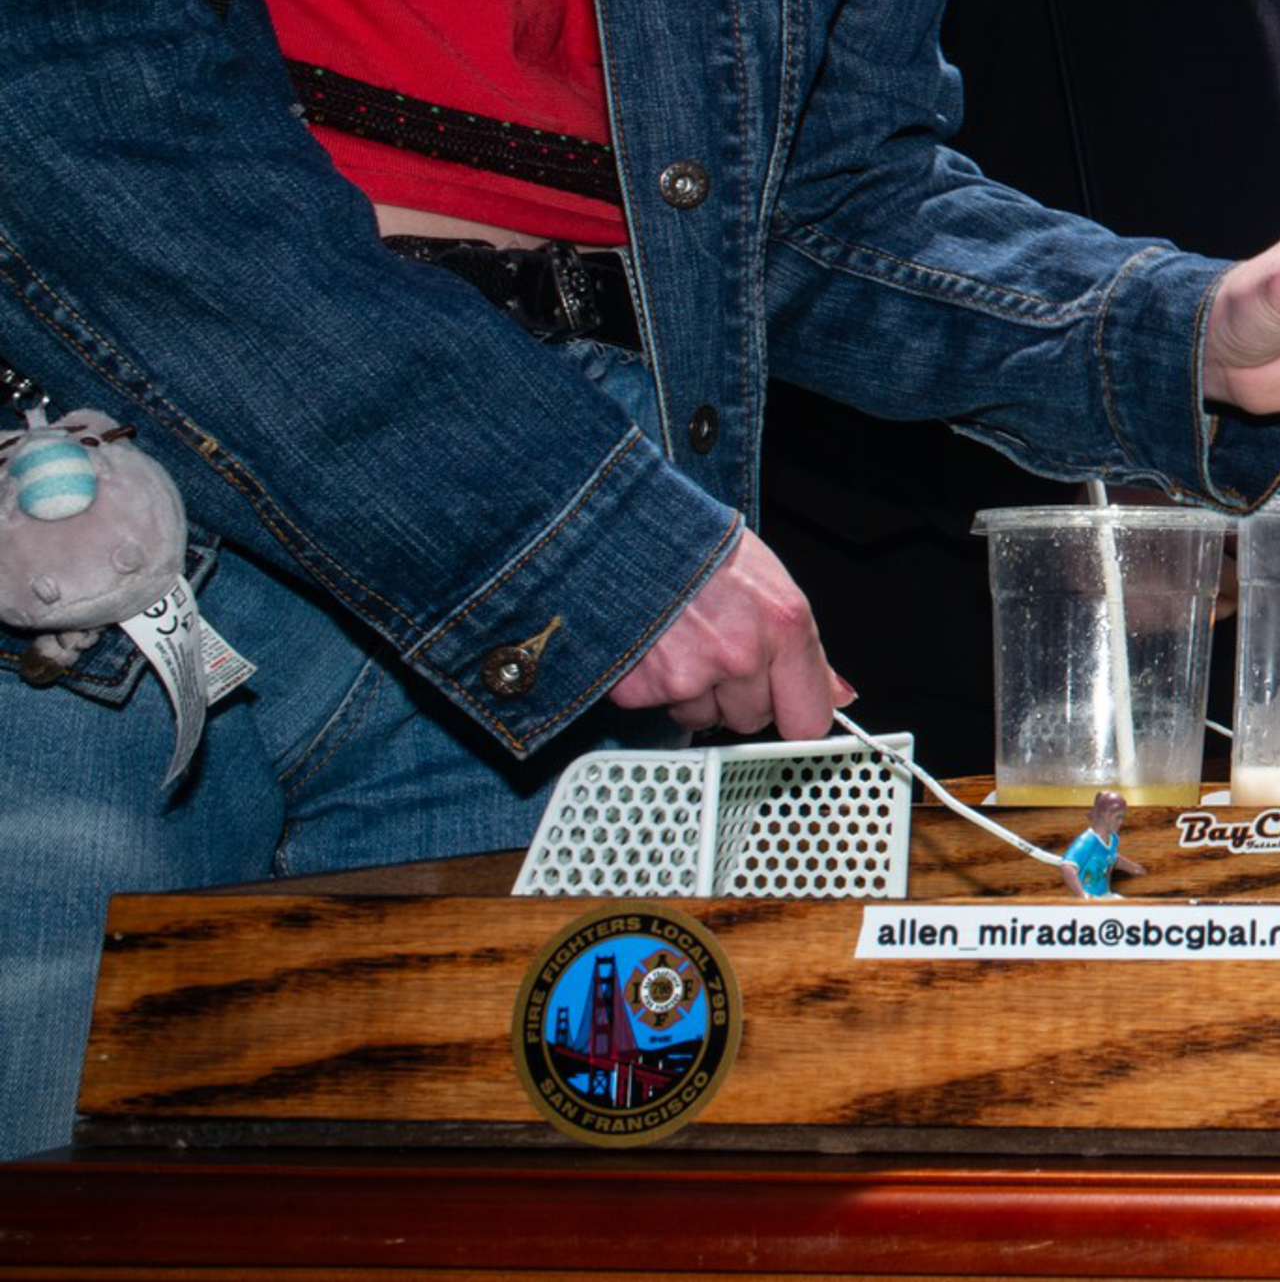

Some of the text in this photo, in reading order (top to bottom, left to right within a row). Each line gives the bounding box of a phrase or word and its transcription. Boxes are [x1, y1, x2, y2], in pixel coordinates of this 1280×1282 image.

[1180, 815, 1253, 849] Bay
[527, 987, 546, 1044] FIRE
[543, 917, 642, 984] FIGHTERS
[651, 919, 711, 972] LOCAL
[708, 975, 728, 1026] 798
[539, 1070, 710, 1133] SAN FRANCISCO
